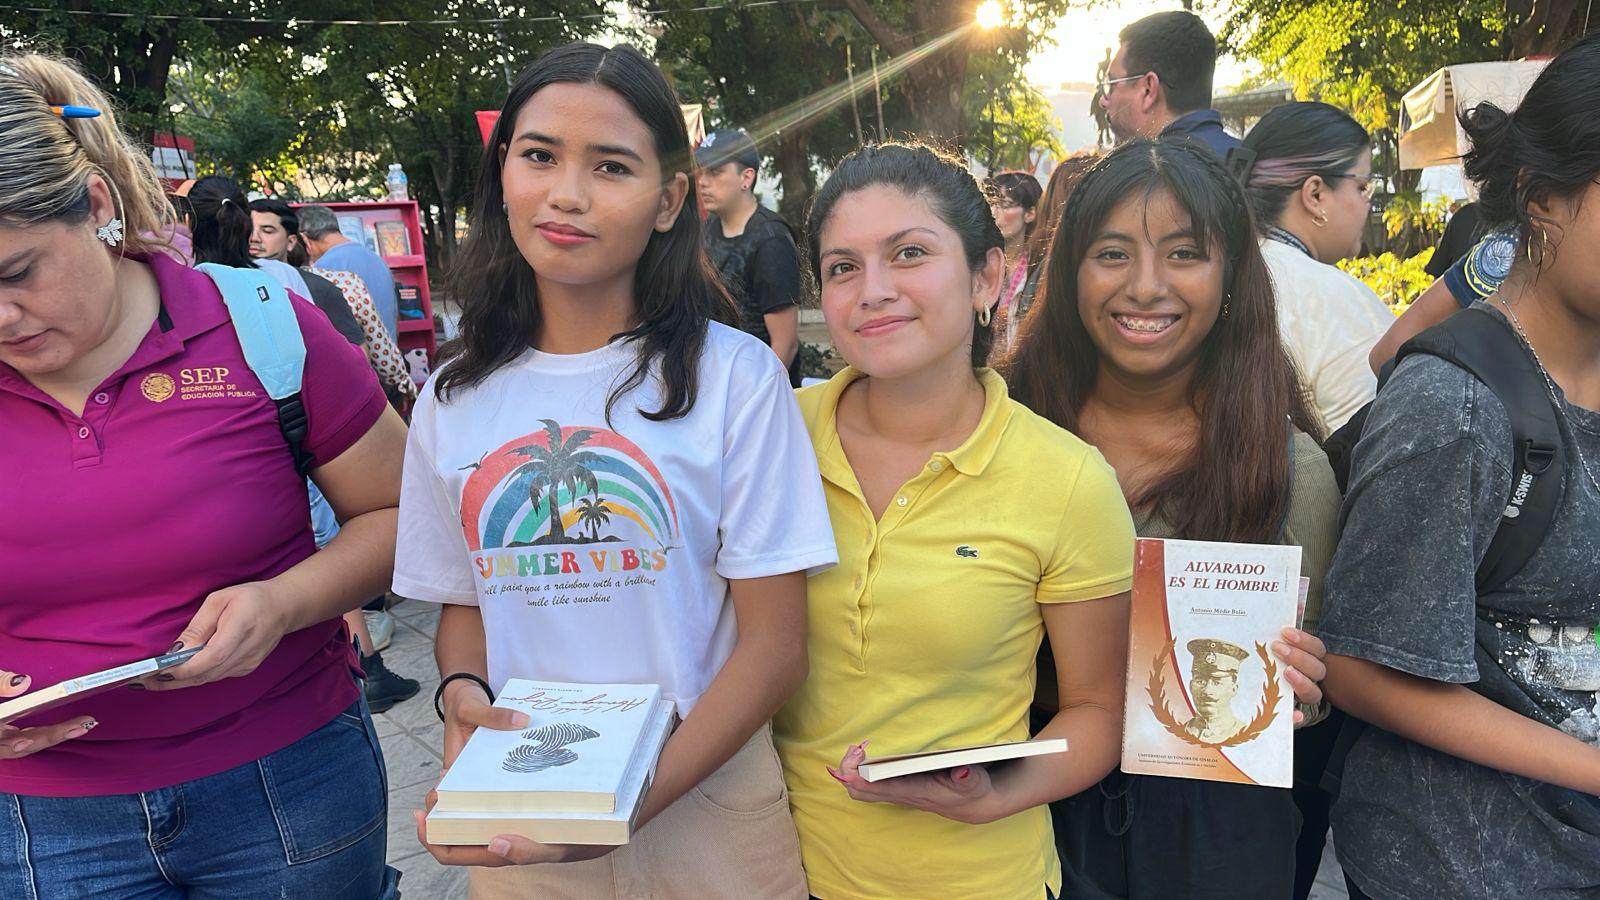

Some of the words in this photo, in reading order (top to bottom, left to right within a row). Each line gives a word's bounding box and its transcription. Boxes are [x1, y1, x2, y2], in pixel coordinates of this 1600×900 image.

[180, 367, 230, 385] SEP
[475, 551, 581, 579] SUMMER
[588, 548, 667, 573] VIBES
[1184, 561, 1266, 576] ALVARADO
[499, 583, 523, 595] paint
[524, 584, 541, 594] you
[554, 579, 590, 591] rainbow
[593, 577, 612, 589] with
[624, 574, 656, 586] brilliant
[1168, 576, 1187, 588] ES
[1193, 577, 1210, 589] EL
[1215, 579, 1280, 593] HOMBRE
[527, 596, 549, 608] smile
[552, 594, 570, 606] like
[573, 594, 612, 604] sunshine
